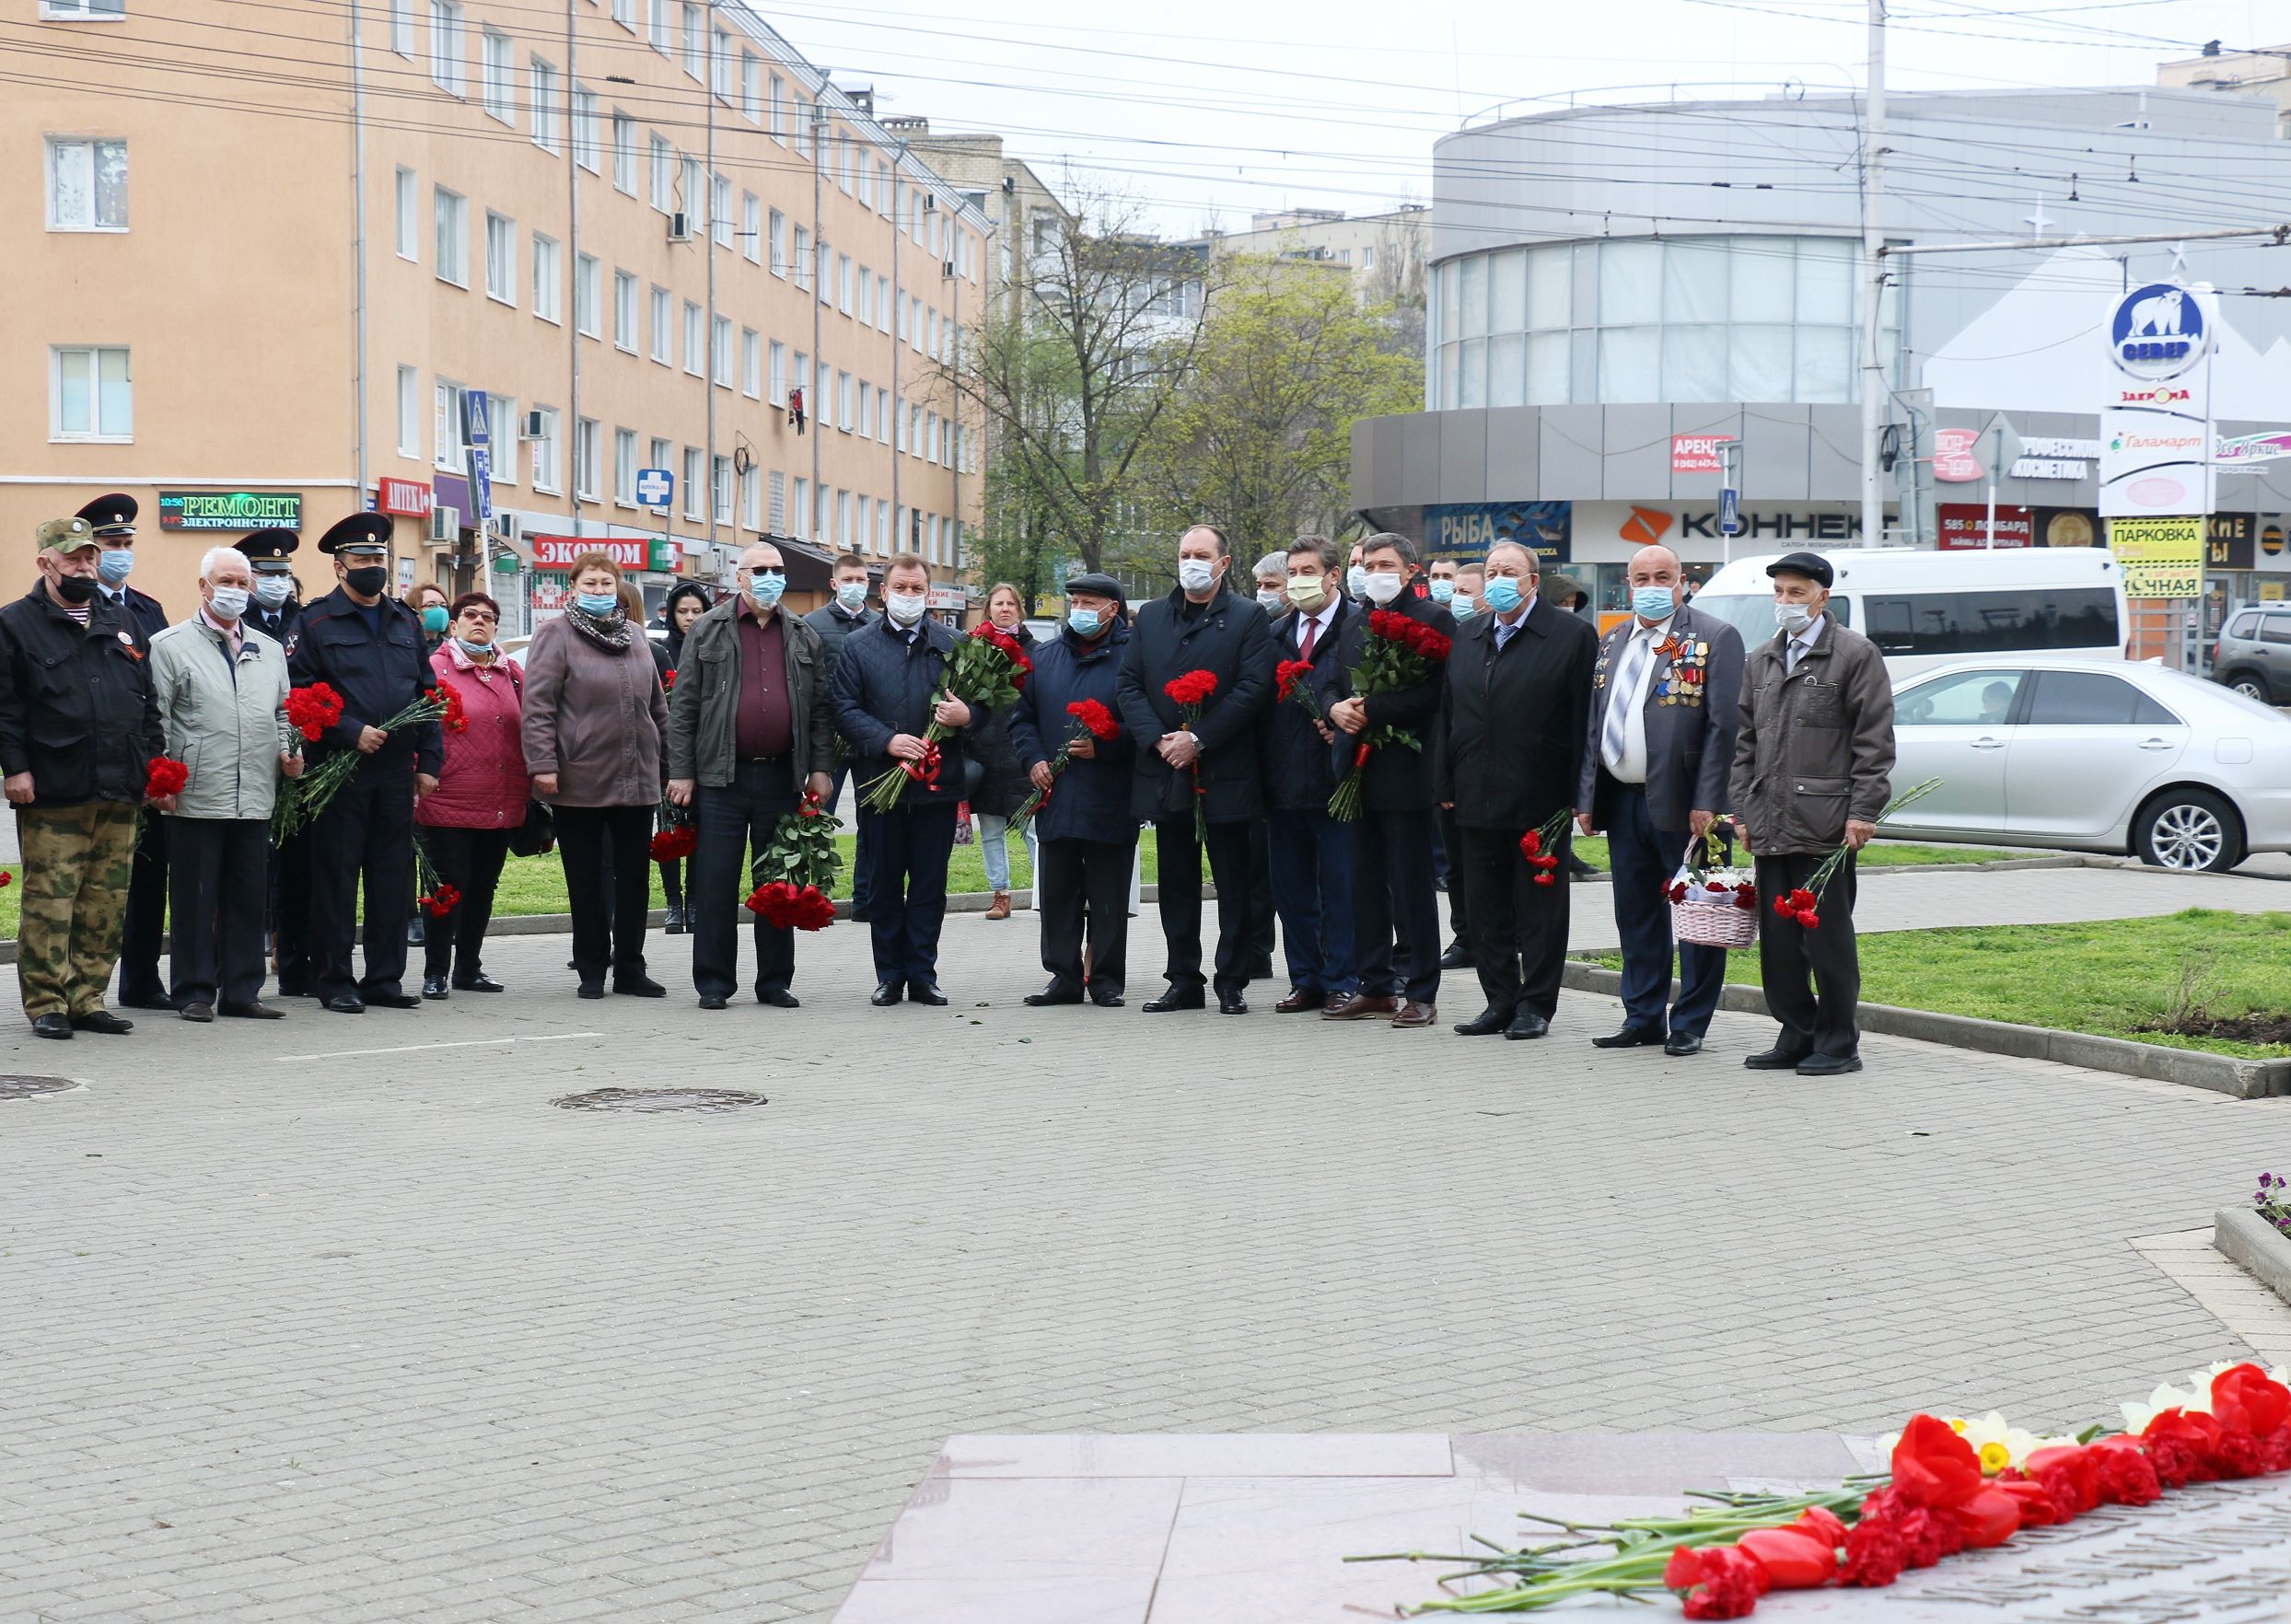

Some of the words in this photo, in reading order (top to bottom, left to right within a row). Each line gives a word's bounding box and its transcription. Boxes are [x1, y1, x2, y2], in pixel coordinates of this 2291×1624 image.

[2122, 342, 2191, 361] СЕВЕР
[1675, 439, 1729, 457] АРЕНД
[2125, 435, 2202, 450] Галамарт
[160, 497, 184, 506] 10:56
[388, 481, 424, 513] АПТЕКА
[181, 496, 300, 517] РЕМОНТ
[181, 517, 299, 528] ЭЛЕКТРОИНСТРУМЕ
[1442, 514, 1495, 545] РЫБА
[1944, 519, 1965, 530] 585
[2114, 528, 2197, 542] ПАРКОВКА
